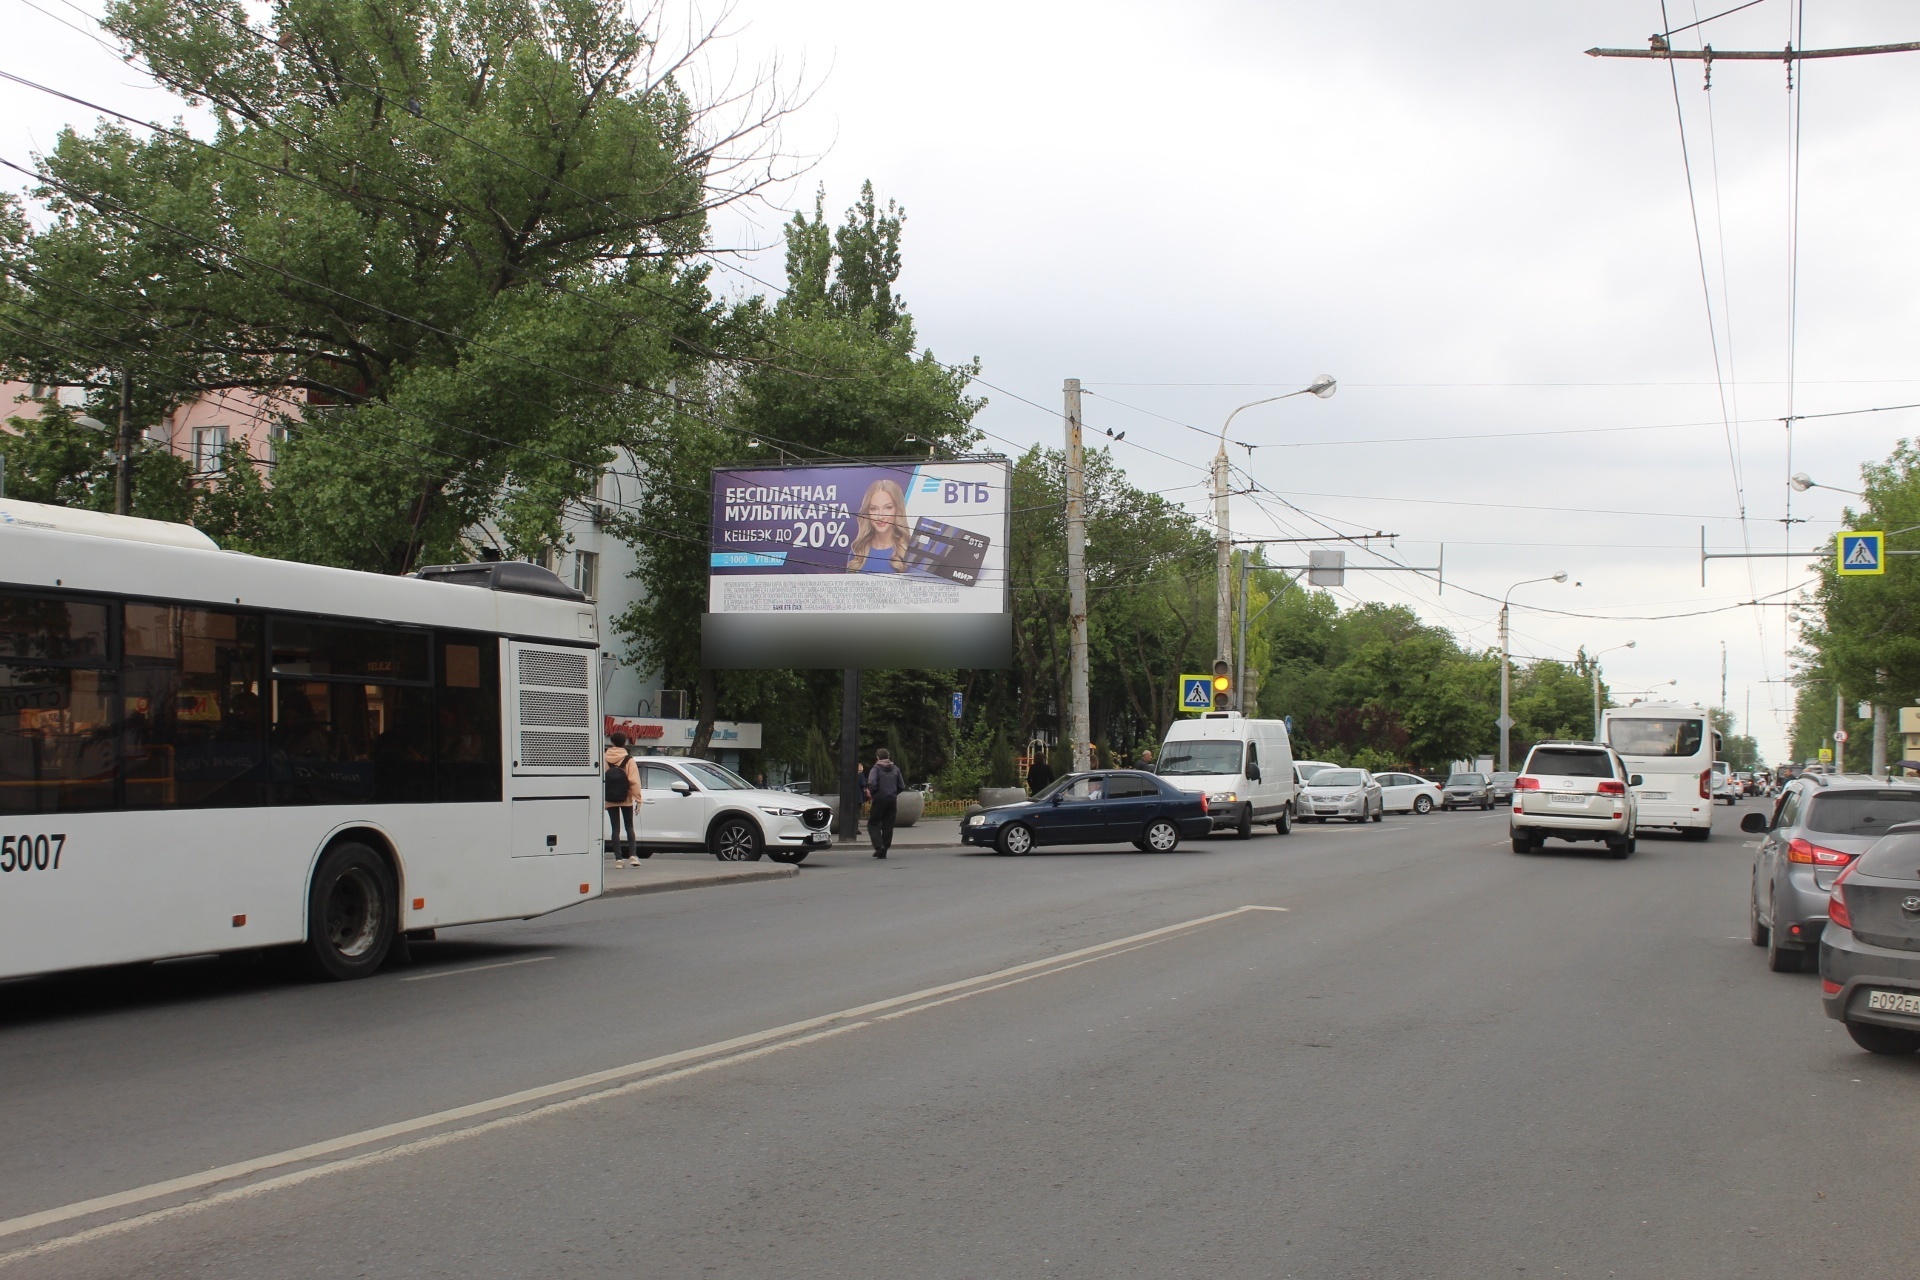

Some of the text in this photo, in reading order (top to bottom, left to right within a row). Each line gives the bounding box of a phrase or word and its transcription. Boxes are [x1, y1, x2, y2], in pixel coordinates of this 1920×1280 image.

[725, 485, 837, 504] БЕСПЛАТНАЯ
[944, 481, 990, 504] ВТБ
[724, 502, 850, 522] МУЛЬТИКАРТА
[724, 521, 850, 548] КЕШБЭК ДО 20%
[968, 538, 984, 548] ВТБ
[754, 555, 782, 564] VTB.RU
[0, 834, 66, 872] 5007
